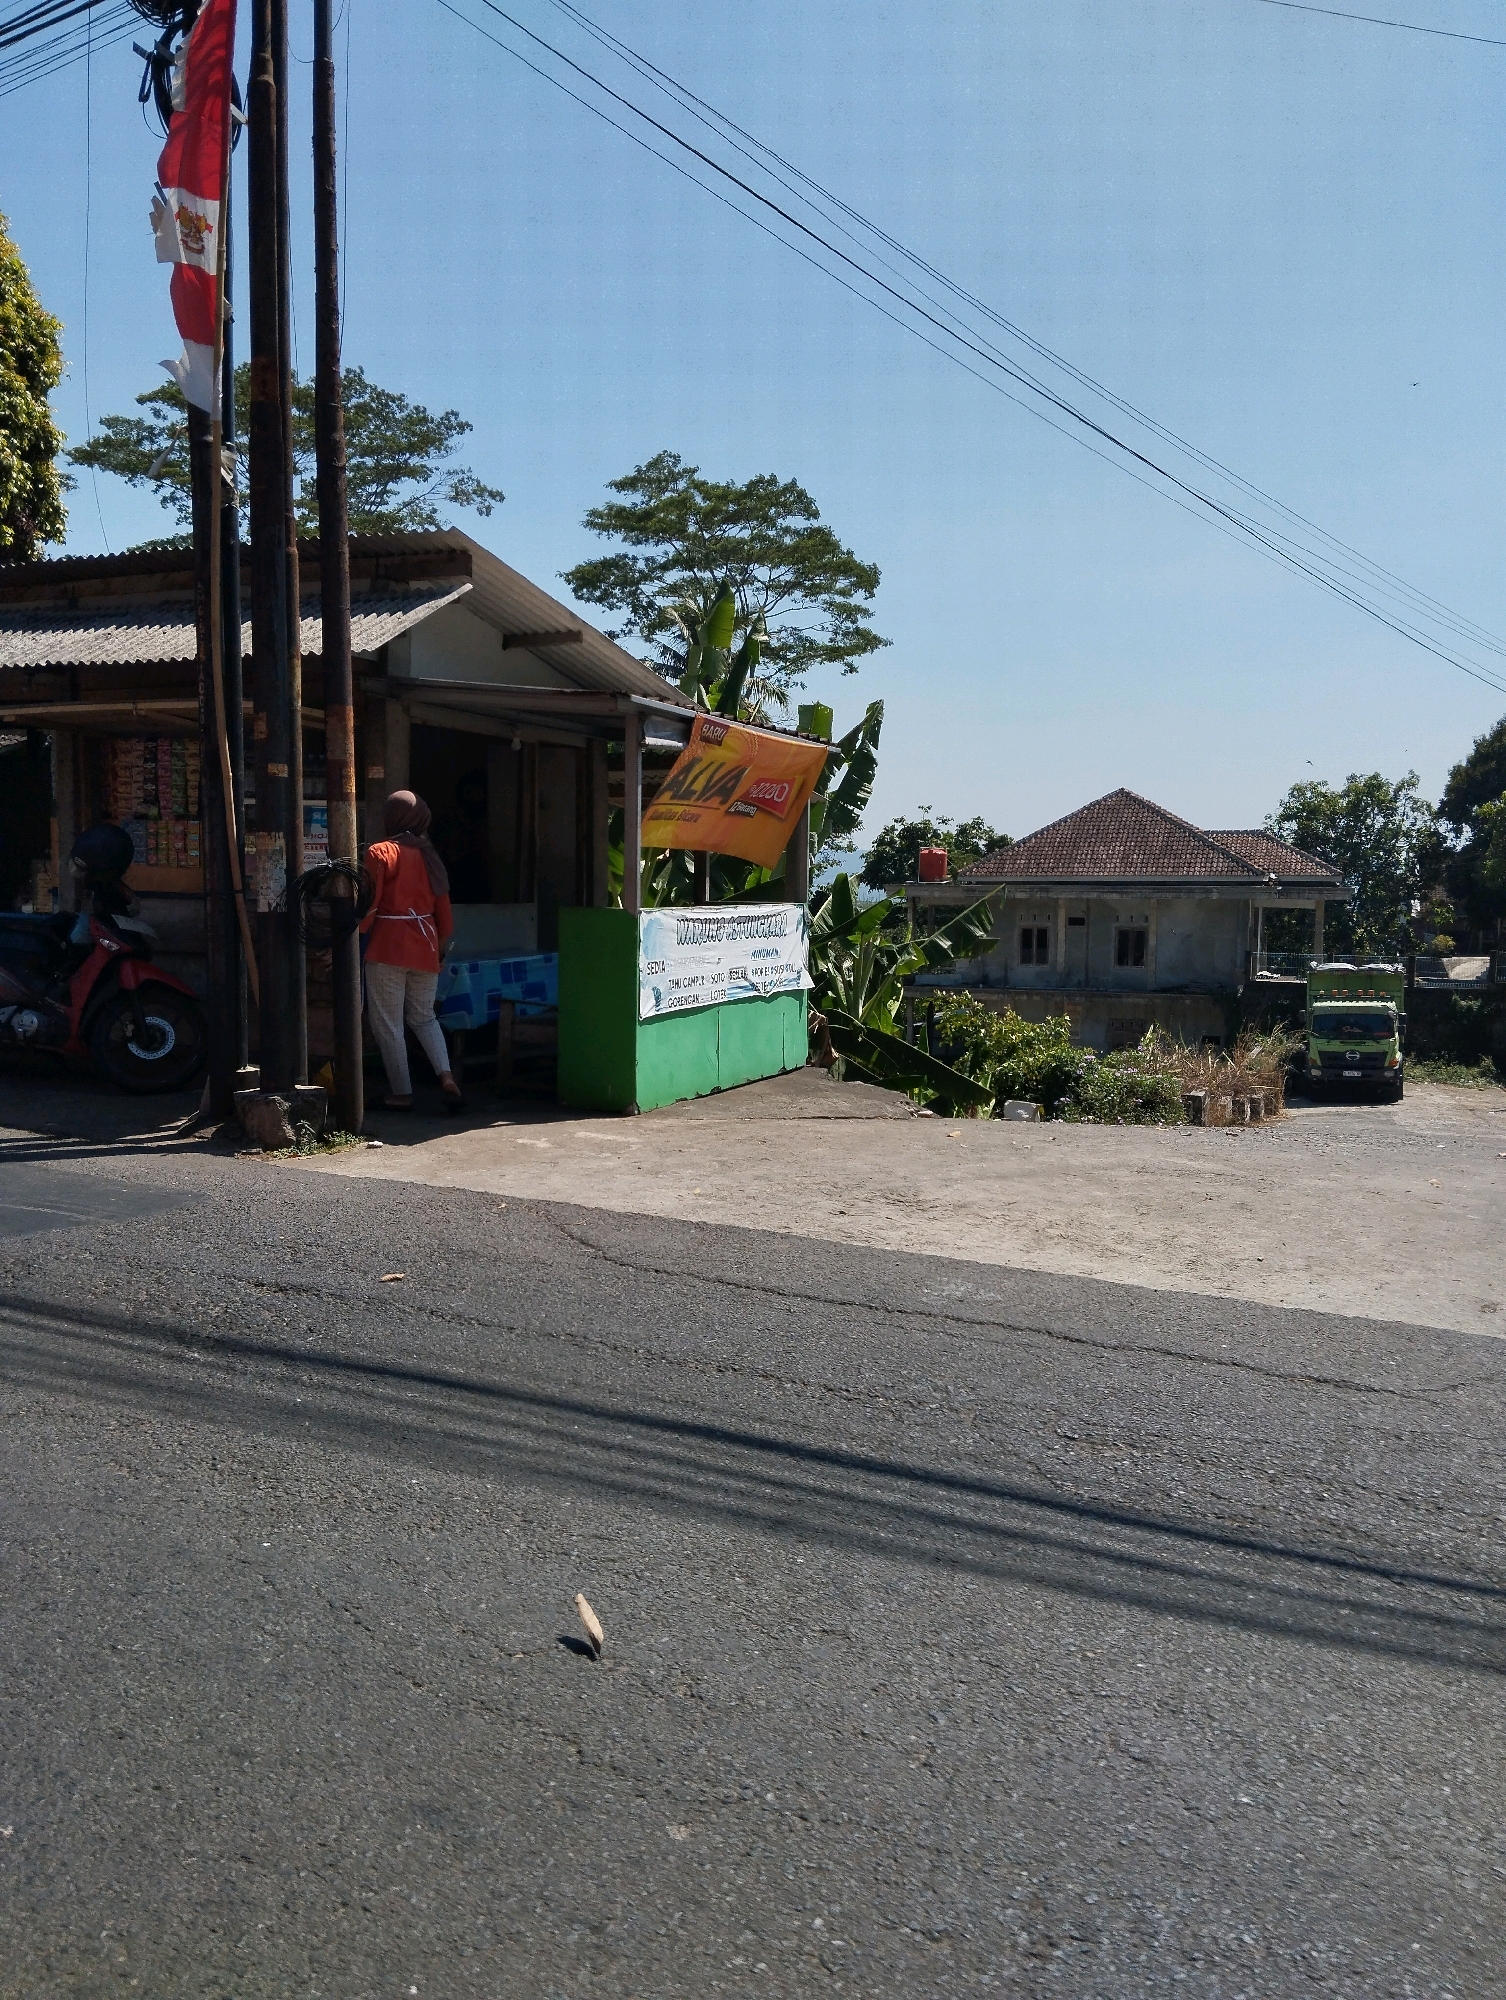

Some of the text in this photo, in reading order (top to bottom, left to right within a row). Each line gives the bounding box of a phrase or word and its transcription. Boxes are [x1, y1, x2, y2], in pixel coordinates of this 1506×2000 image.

[701, 723, 726, 741] BARU
[655, 757, 749, 805] ALVA
[676, 917, 725, 946] WARUNG
[711, 972, 725, 984] SOTO
[668, 994, 700, 1008] GORENGAN
